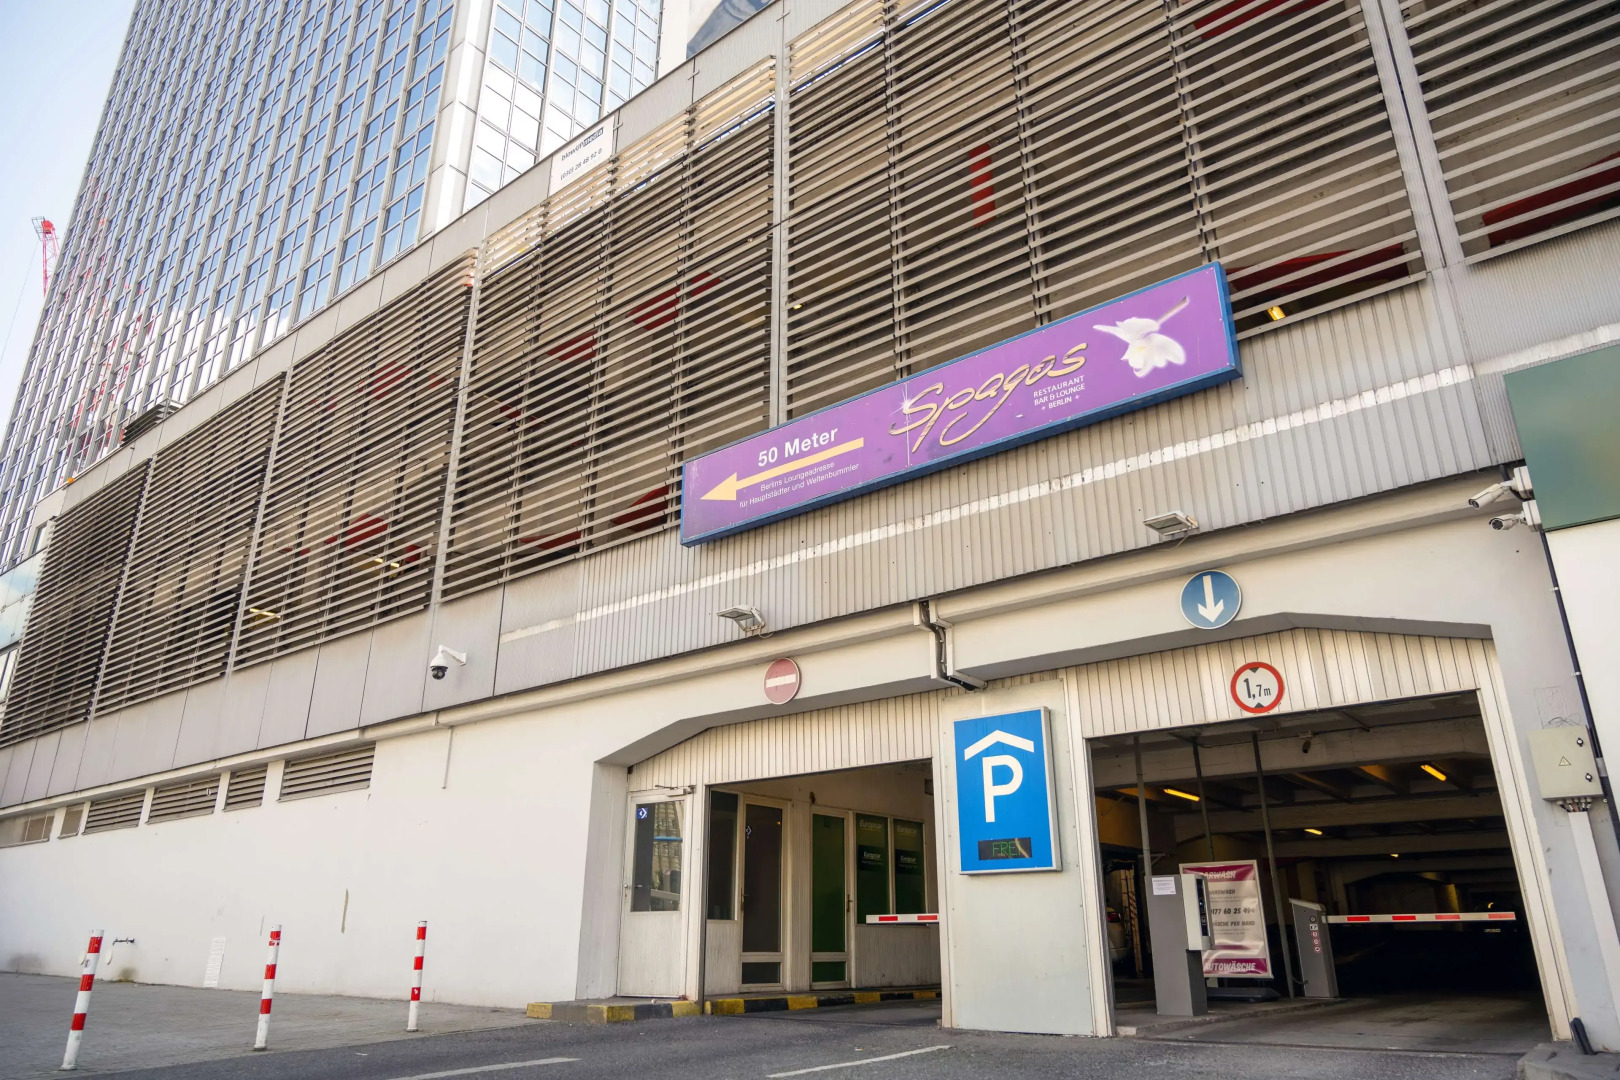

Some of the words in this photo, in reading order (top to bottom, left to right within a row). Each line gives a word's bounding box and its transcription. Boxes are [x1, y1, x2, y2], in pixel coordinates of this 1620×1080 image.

[888, 342, 1088, 453] Spagos
[1033, 374, 1085, 398] RESTAURANT
[1034, 395, 1049, 406] BAR
[1049, 393, 1055, 401] &
[1056, 383, 1086, 399] LOUNGE
[1048, 395, 1073, 409] BERLIN
[757, 446, 778, 467] 50
[784, 427, 838, 458] Meter
[739, 499, 749, 509] für
[749, 486, 790, 505] Hauptstädter
[791, 481, 805, 491] und
[806, 463, 860, 486] Weltenbummler
[760, 478, 783, 492] Berlins
[784, 462, 835, 484] Loungeadresse
[982, 754, 1024, 823] P
[1223, 907, 1231, 915] 60
[1233, 907, 1241, 915] 25
